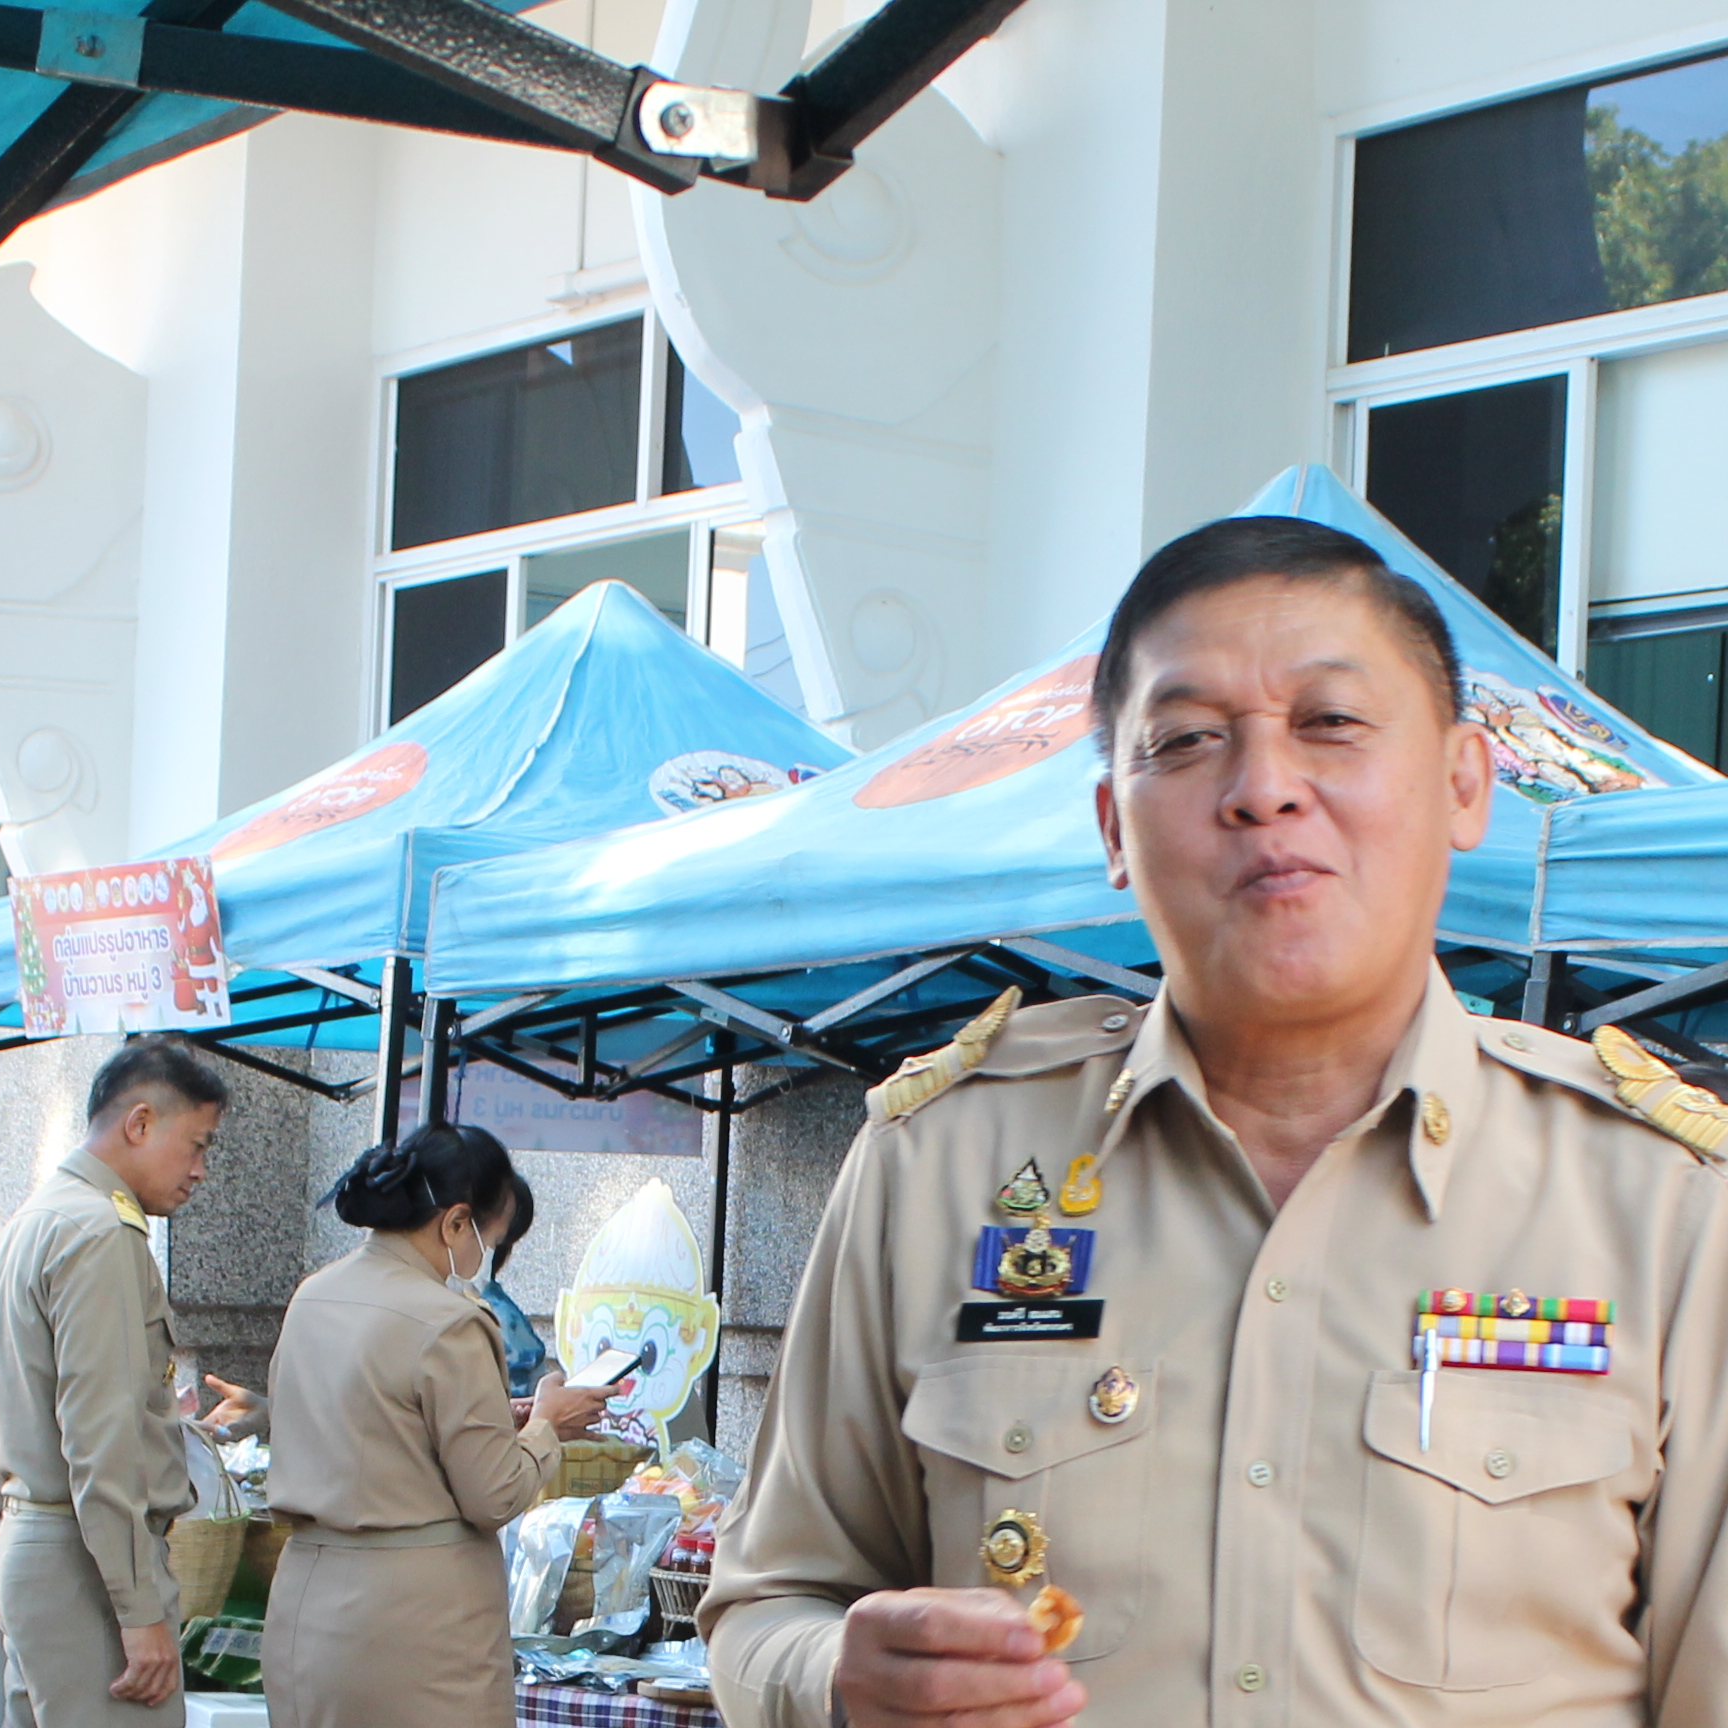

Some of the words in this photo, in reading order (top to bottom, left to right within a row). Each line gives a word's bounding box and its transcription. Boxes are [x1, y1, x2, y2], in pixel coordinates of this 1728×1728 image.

[955, 703, 1084, 741] OTOP
[54, 926, 170, 966] กลุ่มแปรรูปอาหาร
[64, 968, 124, 998] บ้านวานร
[126, 961, 149, 1001] หมู่
[151, 965, 163, 991] 3
